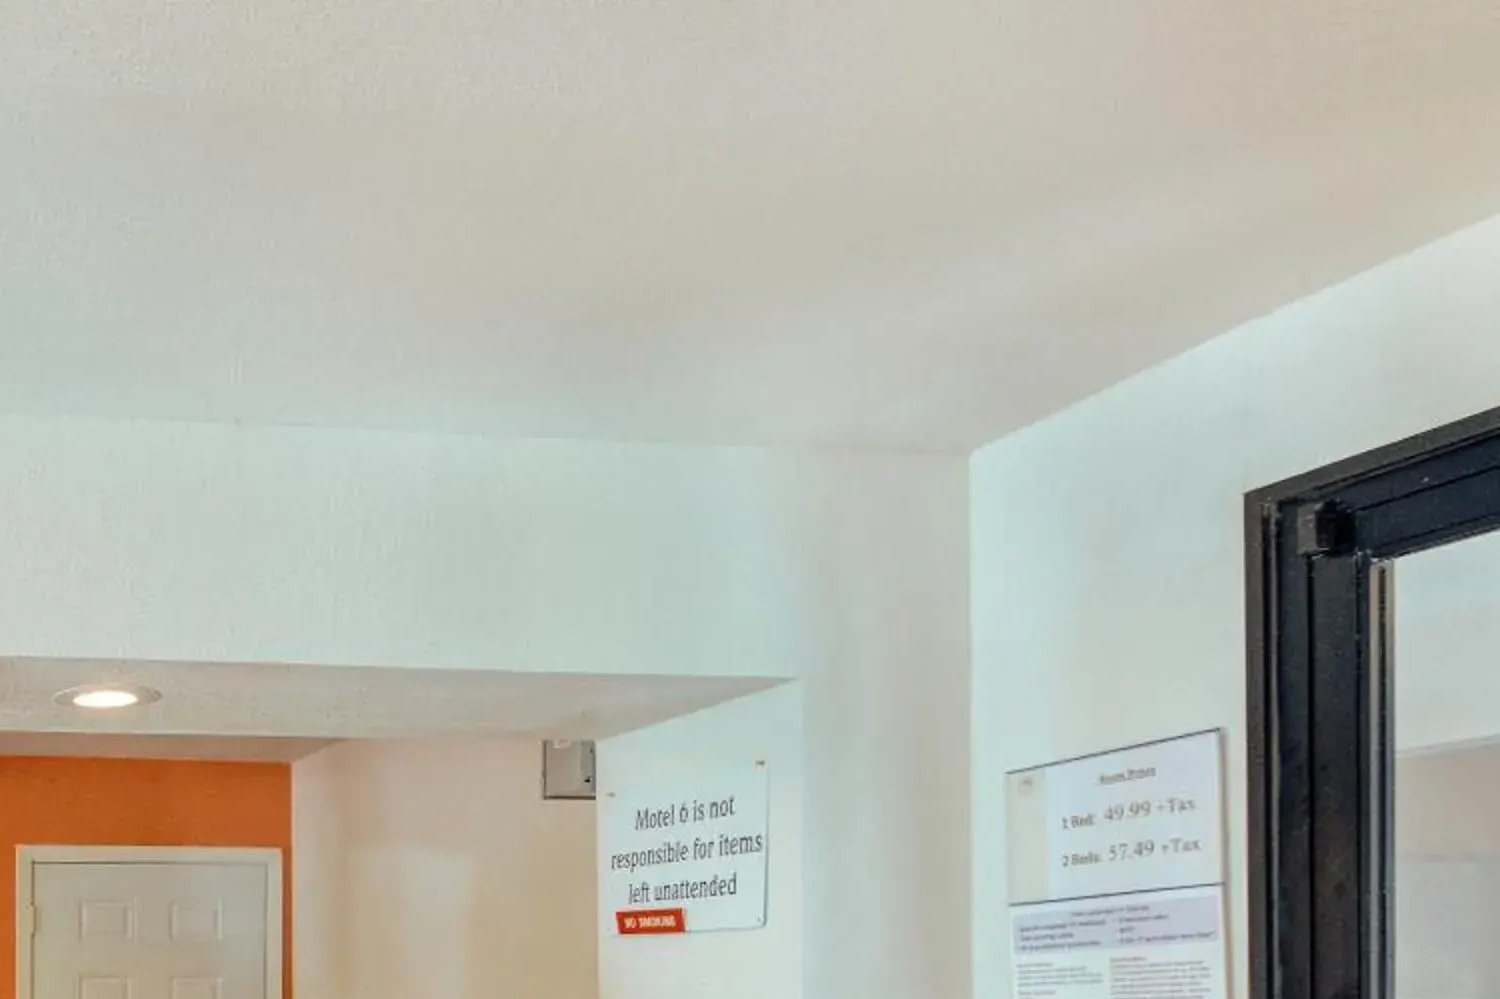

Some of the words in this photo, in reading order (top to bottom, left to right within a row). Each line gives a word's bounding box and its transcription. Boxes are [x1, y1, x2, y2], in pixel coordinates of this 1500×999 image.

[634, 804, 675, 830] Motel
[679, 801, 689, 823] 6
[693, 800, 705, 822] is
[709, 795, 736, 818] not
[610, 840, 689, 873] responsible
[692, 836, 714, 861] for
[719, 833, 763, 857] items
[628, 881, 651, 904] left
[654, 871, 737, 902] unattended
